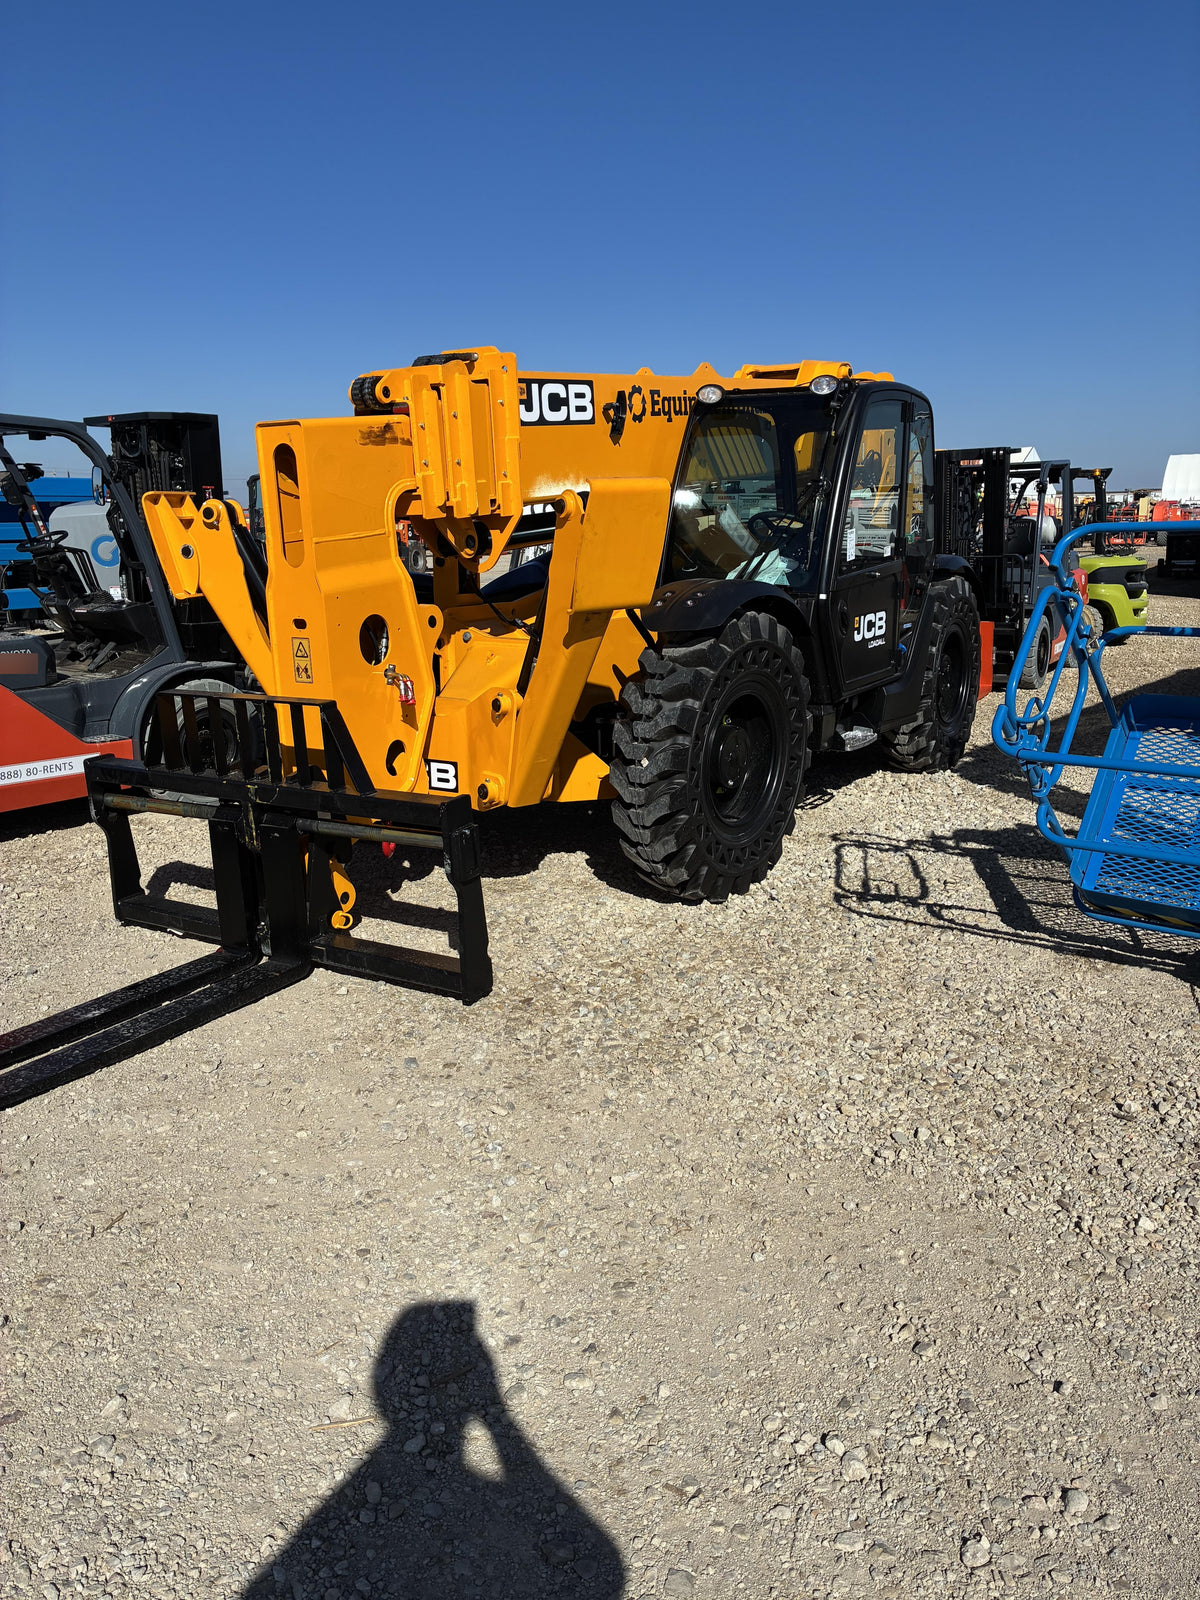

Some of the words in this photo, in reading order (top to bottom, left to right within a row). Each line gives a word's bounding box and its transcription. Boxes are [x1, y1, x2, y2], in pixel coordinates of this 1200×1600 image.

[519, 383, 593, 422] JCB
[854, 611, 887, 642] JCB
[26, 761, 74, 777] 80-RENTS
[426, 761, 457, 790] B
